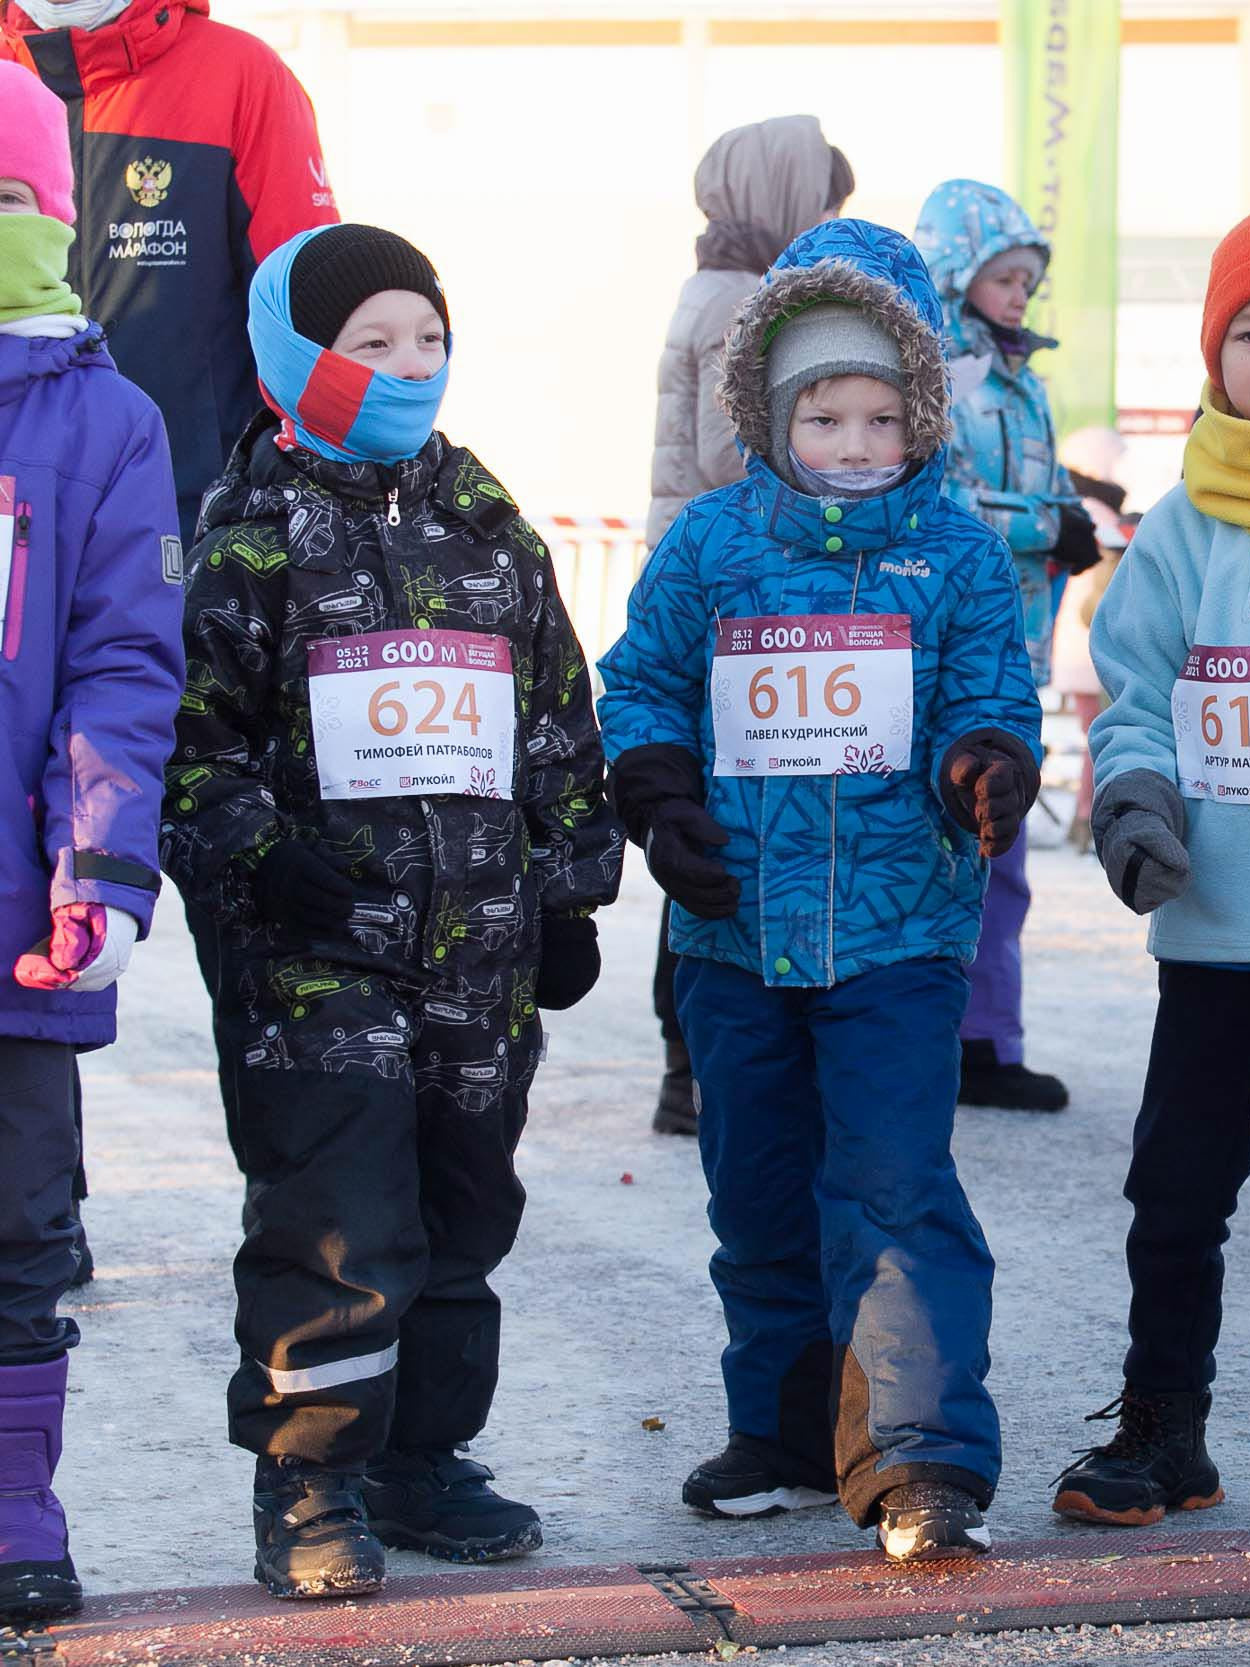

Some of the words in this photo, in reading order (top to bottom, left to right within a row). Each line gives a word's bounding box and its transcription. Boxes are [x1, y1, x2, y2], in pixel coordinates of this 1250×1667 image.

[109, 220, 187, 239] ВОЛОГДА
[109, 239, 187, 259] МАРАФОН
[733, 630, 752, 639] 05.12
[761, 627, 805, 648] 600
[814, 632, 832, 647] М
[849, 630, 884, 639] БЕГУЩАЯ
[732, 641, 752, 650] 2021
[849, 638, 884, 647] ВОЛОГДА
[336, 645, 369, 657] 05.12
[382, 641, 434, 663] 600
[441, 647, 457, 663] М
[337, 658, 368, 668] 2021
[1206, 657, 1248, 678] 600
[748, 663, 862, 719] 616
[368, 680, 481, 736] 624
[745, 729, 779, 741] ПАВЕЛ
[781, 724, 868, 742] КУДРИНСКИЙ
[354, 744, 423, 760] ТИМОФЕЙ
[426, 744, 493, 760] ПАТРАБОЛОВ
[778, 757, 821, 768] ЛУКОЙЛ
[1204, 755, 1229, 768] АРТУР
[411, 775, 455, 787] ЛУКОЙЛ
